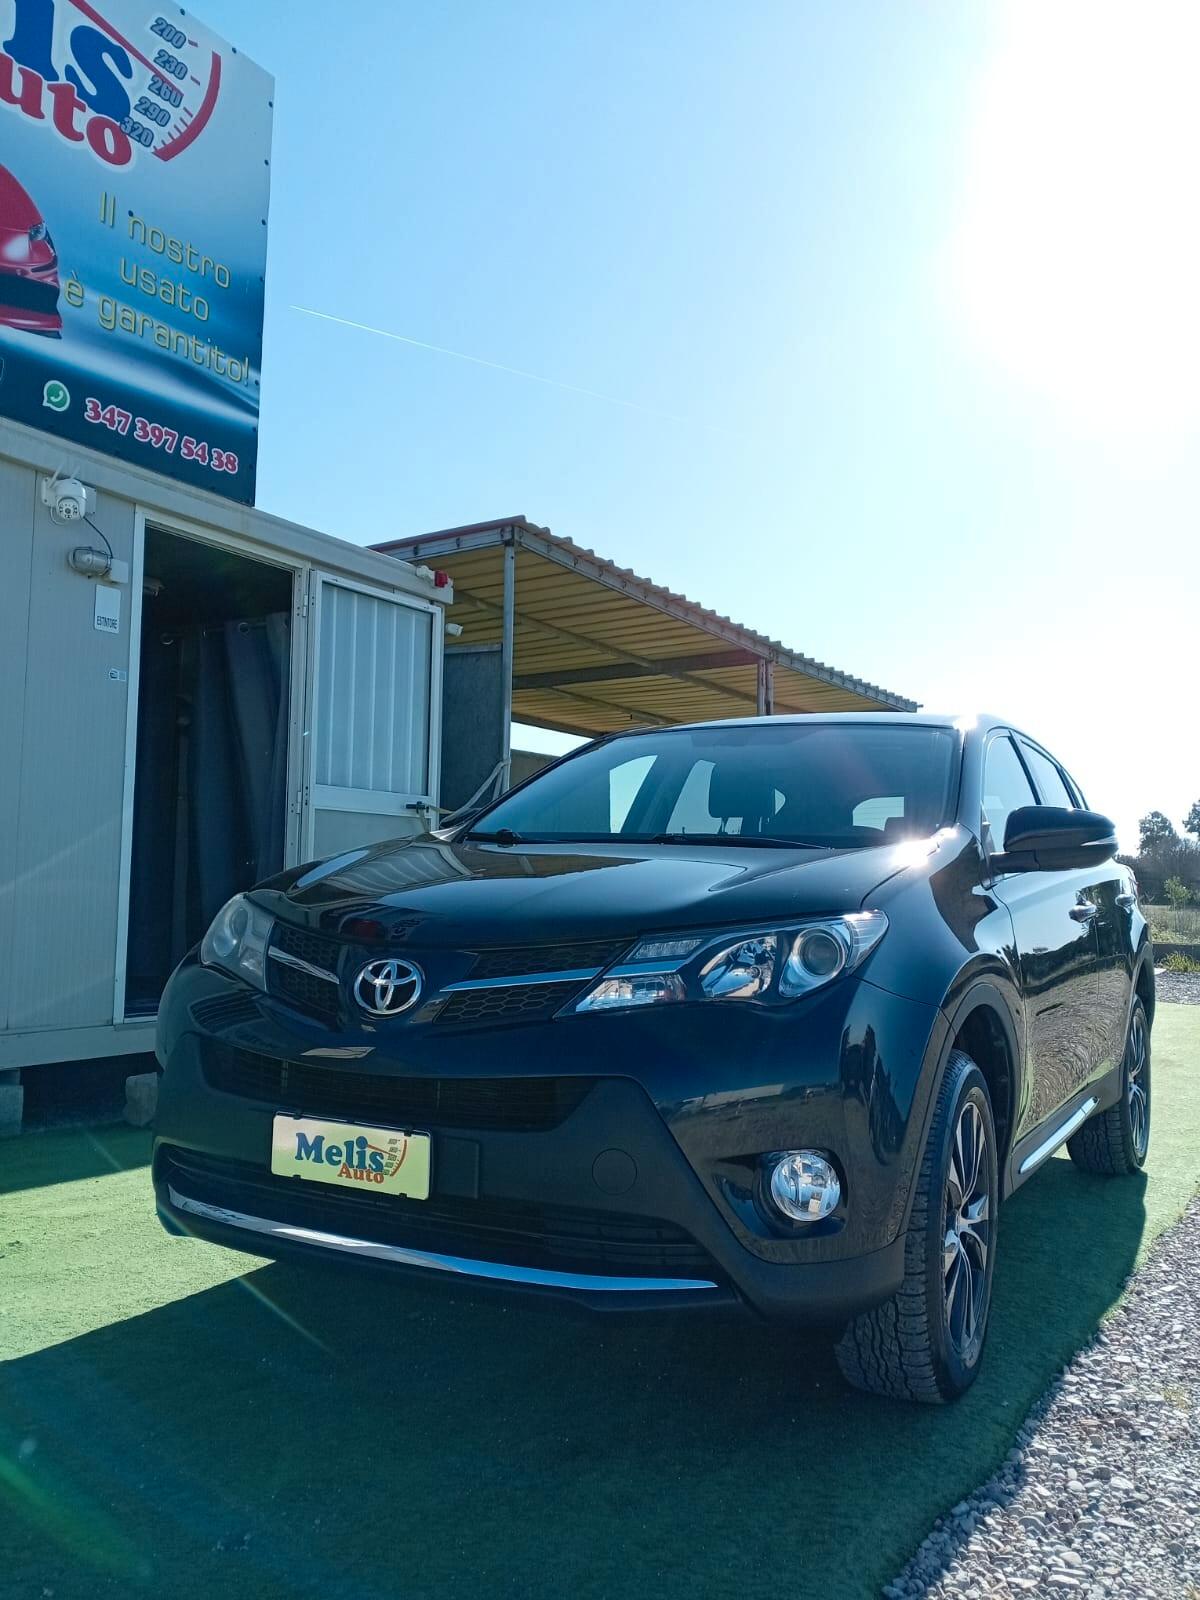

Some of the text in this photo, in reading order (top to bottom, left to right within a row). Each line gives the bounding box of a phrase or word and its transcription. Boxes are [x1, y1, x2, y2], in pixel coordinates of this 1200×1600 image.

[150, 17, 186, 49] 200
[154, 49, 188, 80] 230
[148, 76, 183, 108] 260
[134, 96, 171, 127] 290
[119, 117, 155, 148] 320
[99, 191, 231, 289] Il nostro
[120, 256, 210, 322] usato
[64, 269, 249, 387] è garantito!
[84, 397, 238, 474] 347 397 54 38
[295, 1132, 385, 1173] Melis
[337, 1163, 384, 1184] Auto
